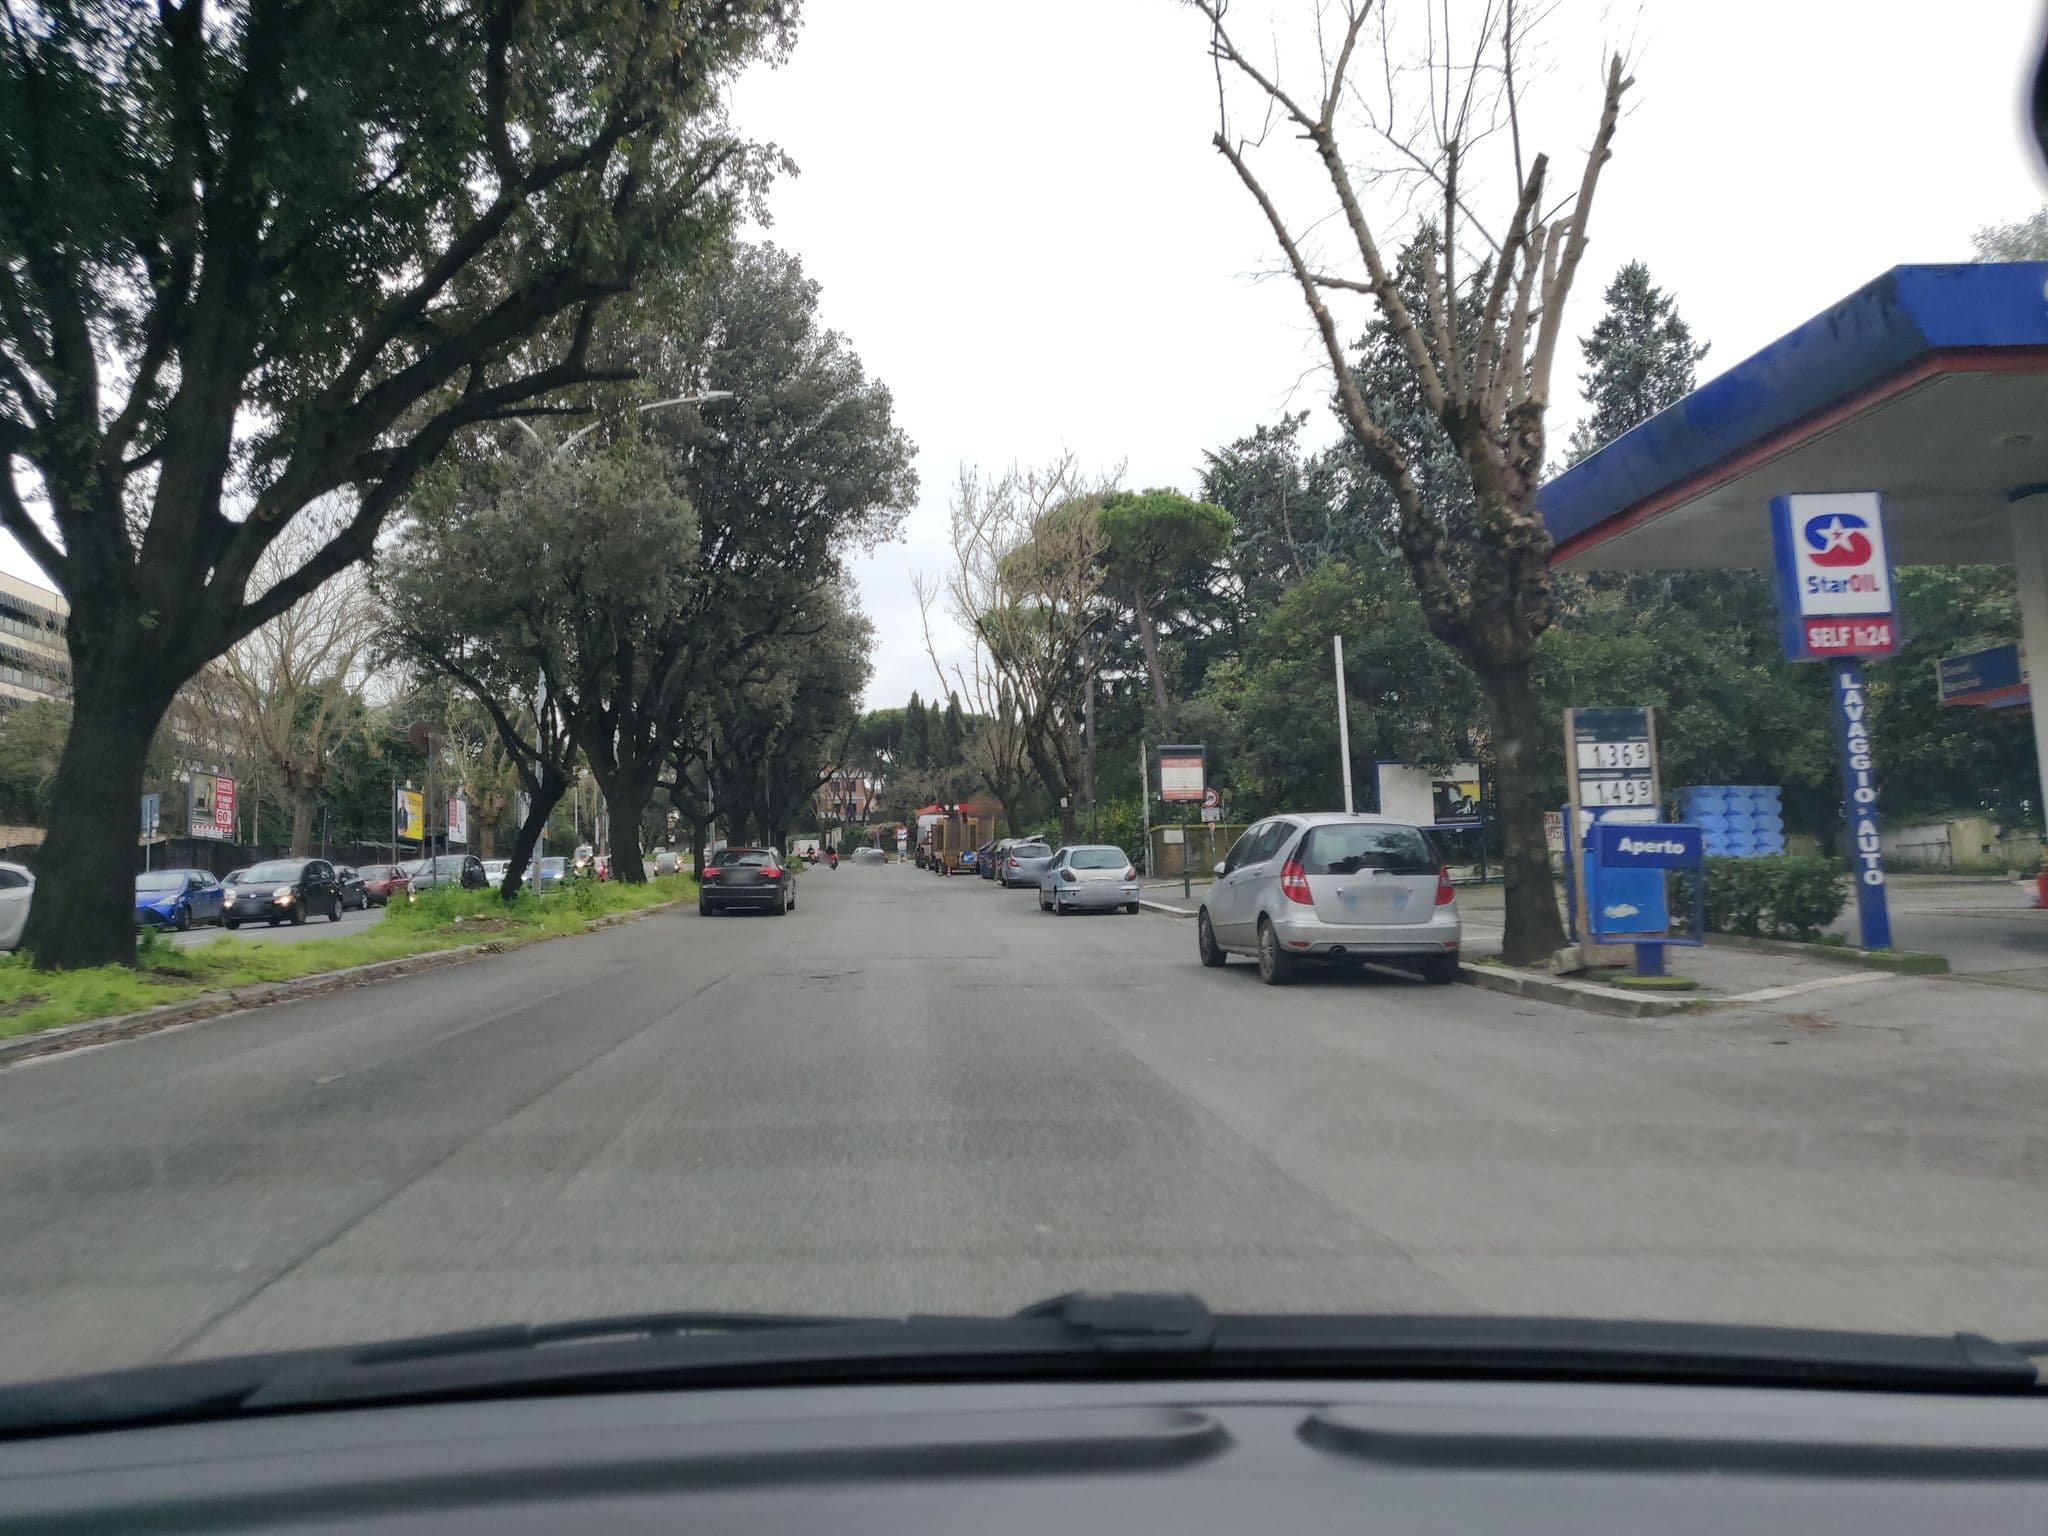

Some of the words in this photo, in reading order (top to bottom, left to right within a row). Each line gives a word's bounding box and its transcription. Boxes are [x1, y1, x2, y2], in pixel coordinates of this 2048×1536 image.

[1808, 575, 1881, 593] StarOIL
[1809, 626, 1850, 648] SELF
[1854, 625, 1890, 647] h24
[1840, 673, 1876, 803] LAVAGGIO
[1617, 837, 1685, 856] Aperto
[1857, 820, 1885, 886] AUTO
